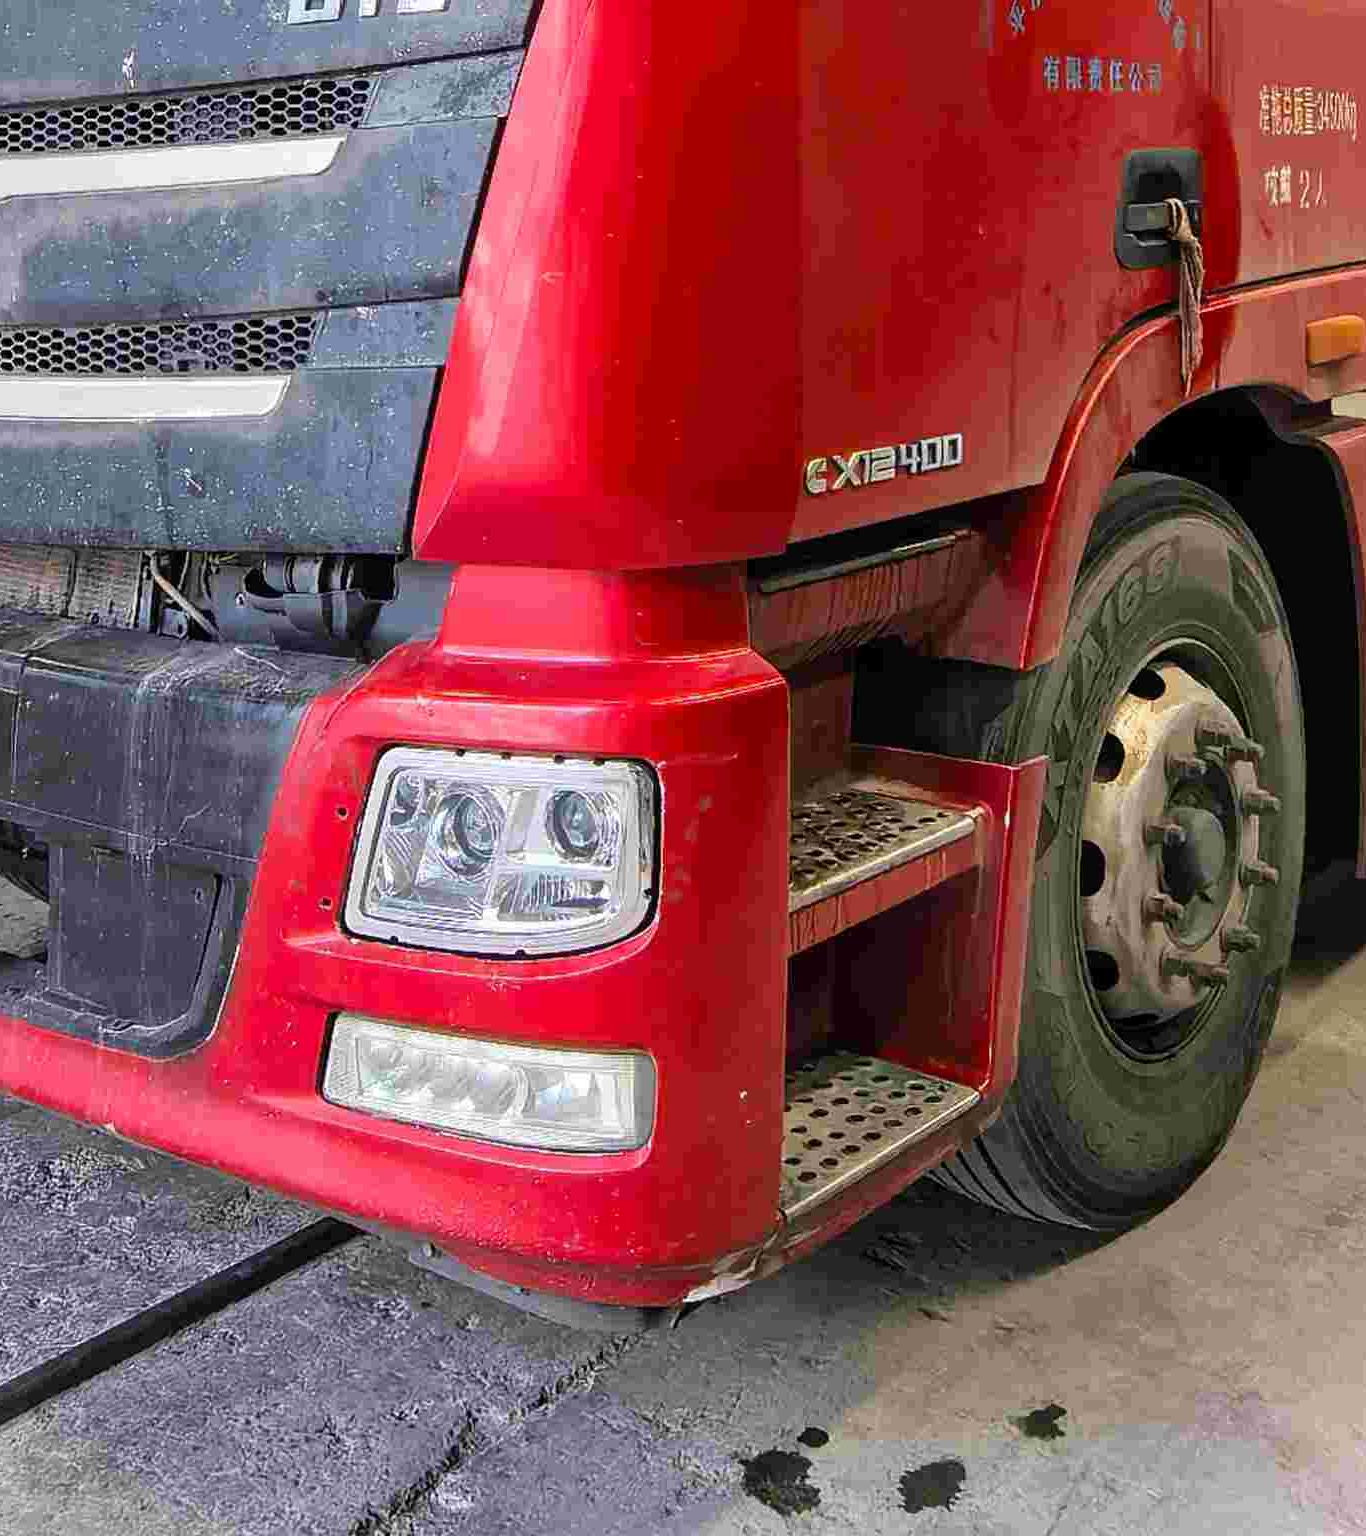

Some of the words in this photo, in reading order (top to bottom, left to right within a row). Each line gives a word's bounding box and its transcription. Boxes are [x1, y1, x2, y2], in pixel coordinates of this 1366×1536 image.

[1043, 54, 1163, 94] 有限责任公司
